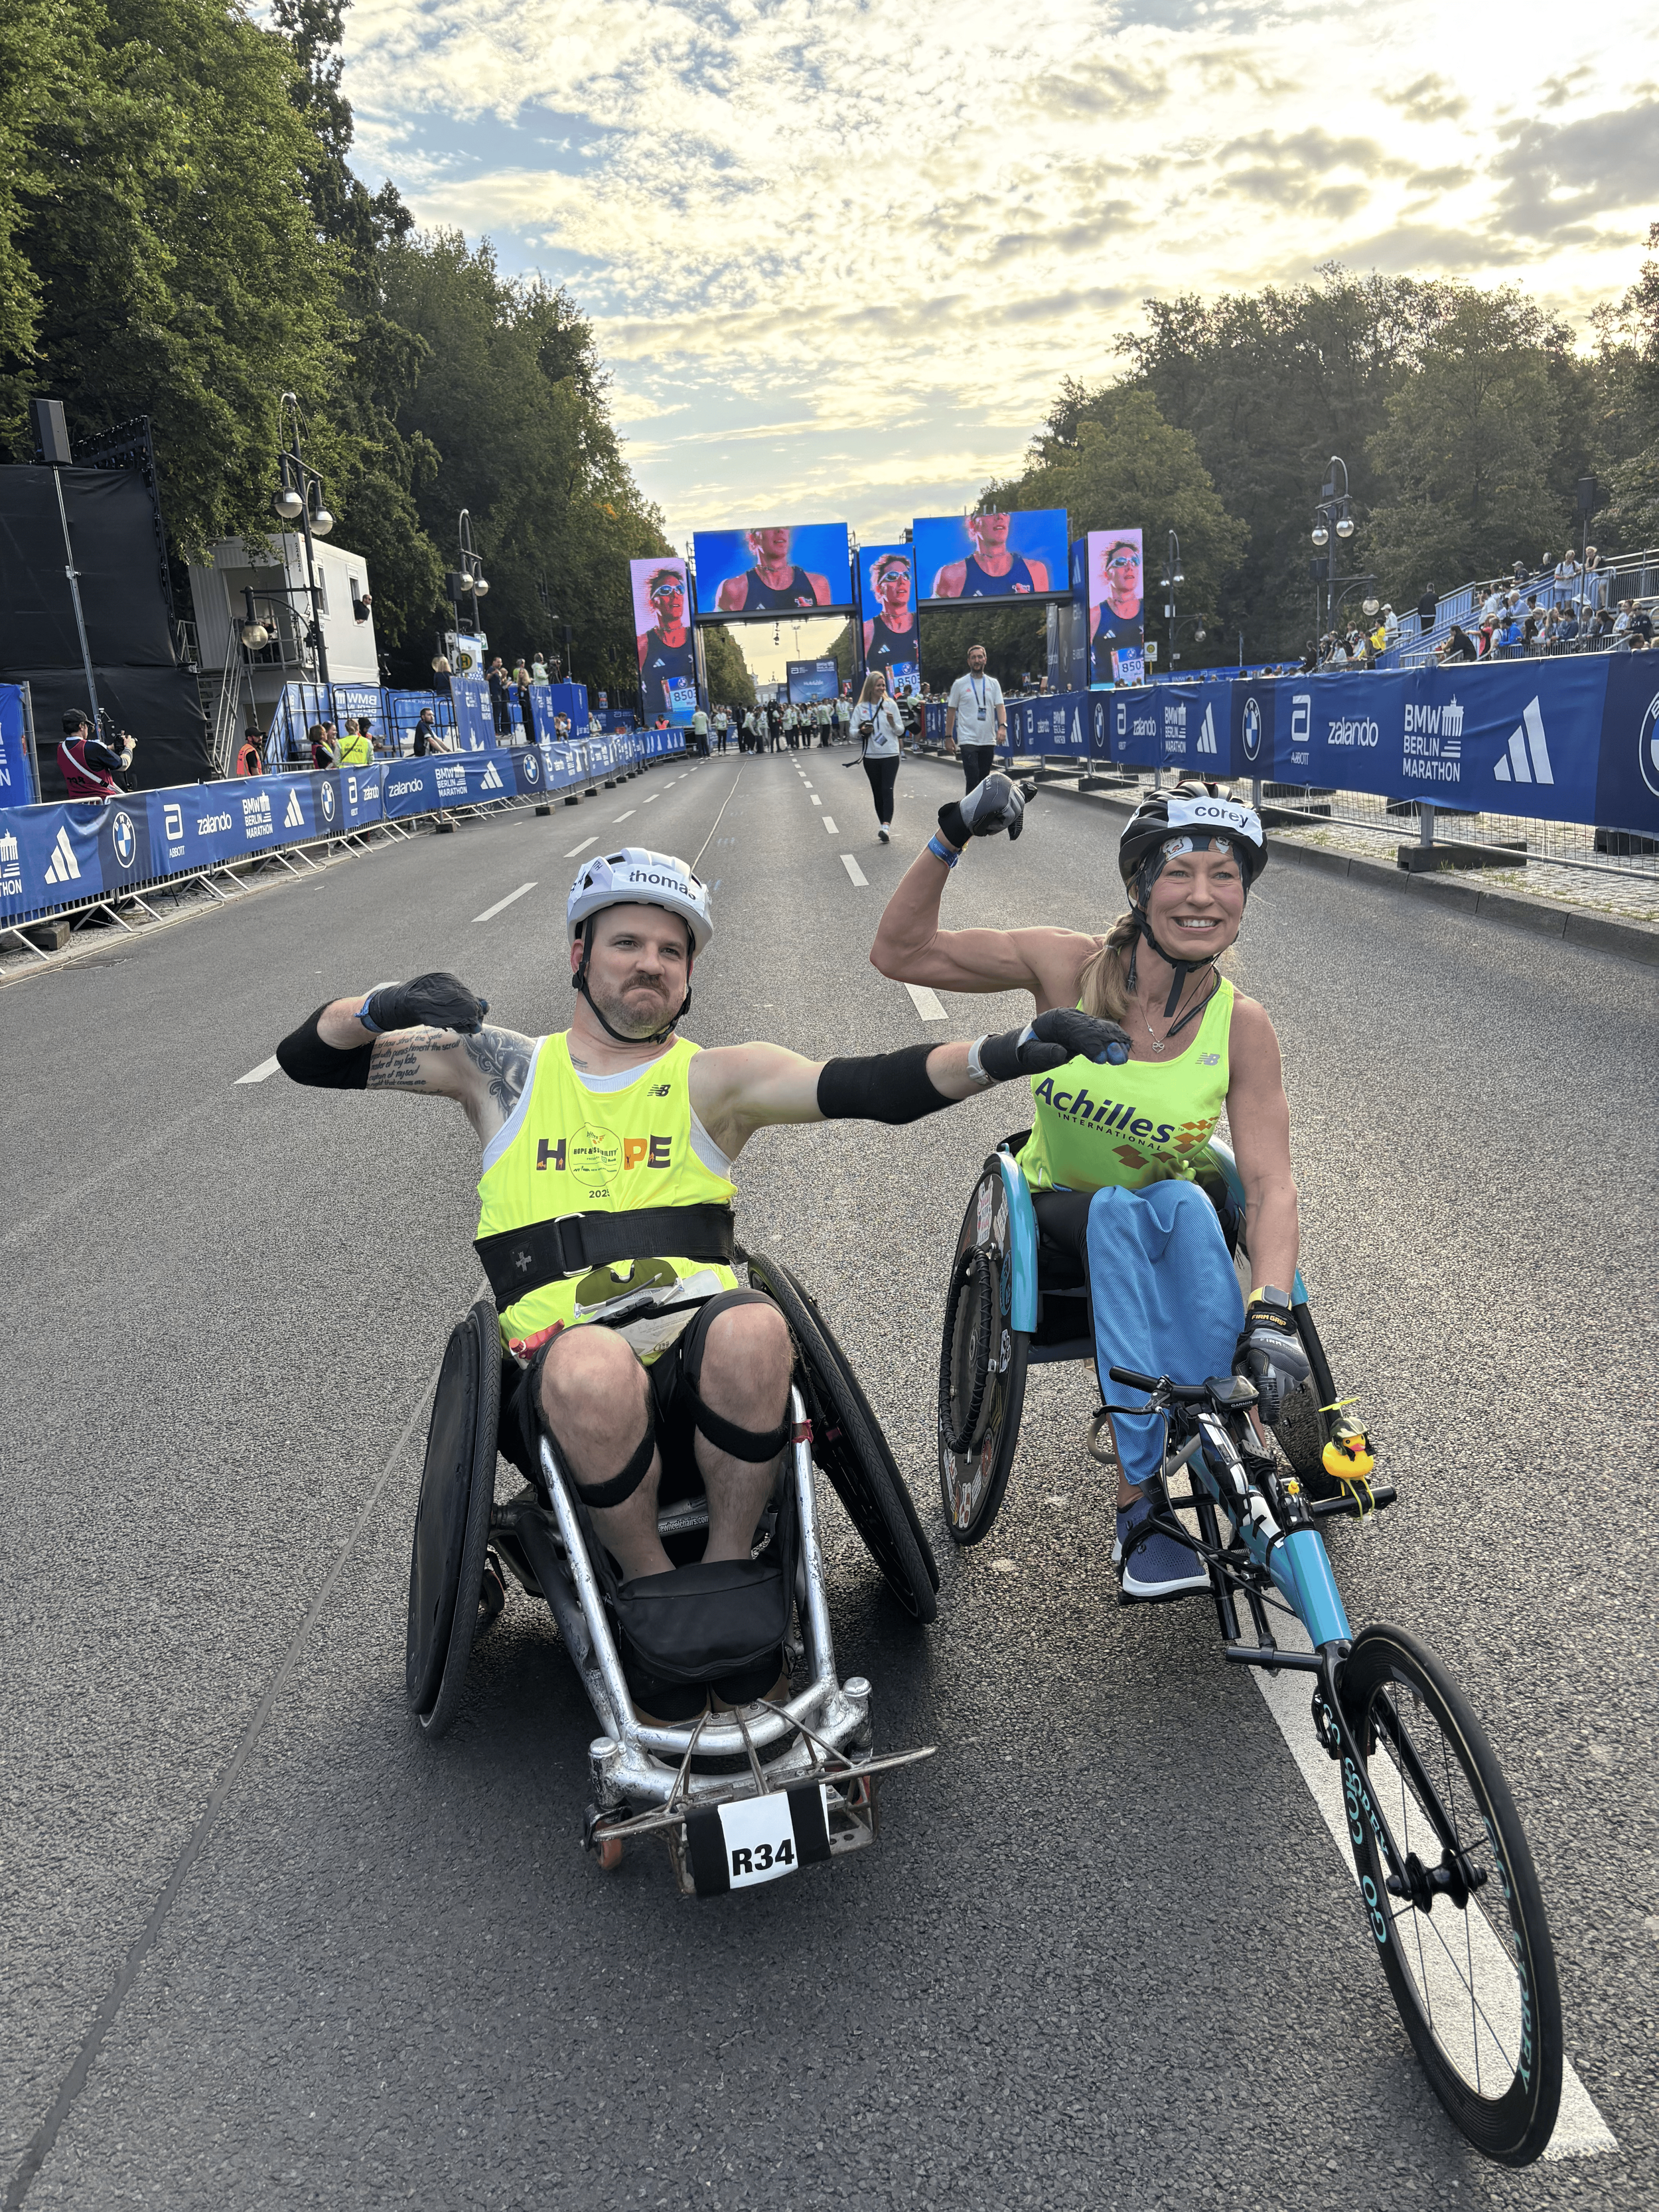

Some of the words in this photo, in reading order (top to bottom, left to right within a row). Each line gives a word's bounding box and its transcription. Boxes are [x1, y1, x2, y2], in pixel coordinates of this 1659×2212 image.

[1122, 661, 1144, 673] 850
[1165, 706, 1179, 725] BMW
[1404, 703, 1442, 735] BMW
[1133, 716, 1157, 737] zalando
[1165, 726, 1179, 738] BERLIN
[1328, 717, 1379, 747] zalando
[1165, 741, 1187, 753] MARATHON
[1403, 735, 1439, 757] BERLIN
[1291, 751, 1309, 766] ABBOTT
[435, 767, 455, 780] BMW
[1402, 758, 1460, 782] MARATHON
[388, 778, 423, 798] zalando
[437, 778, 456, 789] BERLIN
[438, 786, 468, 797] MARATHON
[242, 797, 260, 815] BMW
[196, 811, 232, 836] zalando
[244, 813, 263, 827] BERLIN
[1194, 806, 1249, 828] corey
[246, 823, 273, 839] MARATHON
[169, 846, 186, 859] ABBOTT
[1035, 1077, 1175, 1143] Achilles
[1058, 1112, 1162, 1151] INTERNATIONAL
[1269, 1315, 1287, 1326] GRIP
[732, 1838, 795, 1877] R34
[1362, 1875, 1386, 1943] GO
